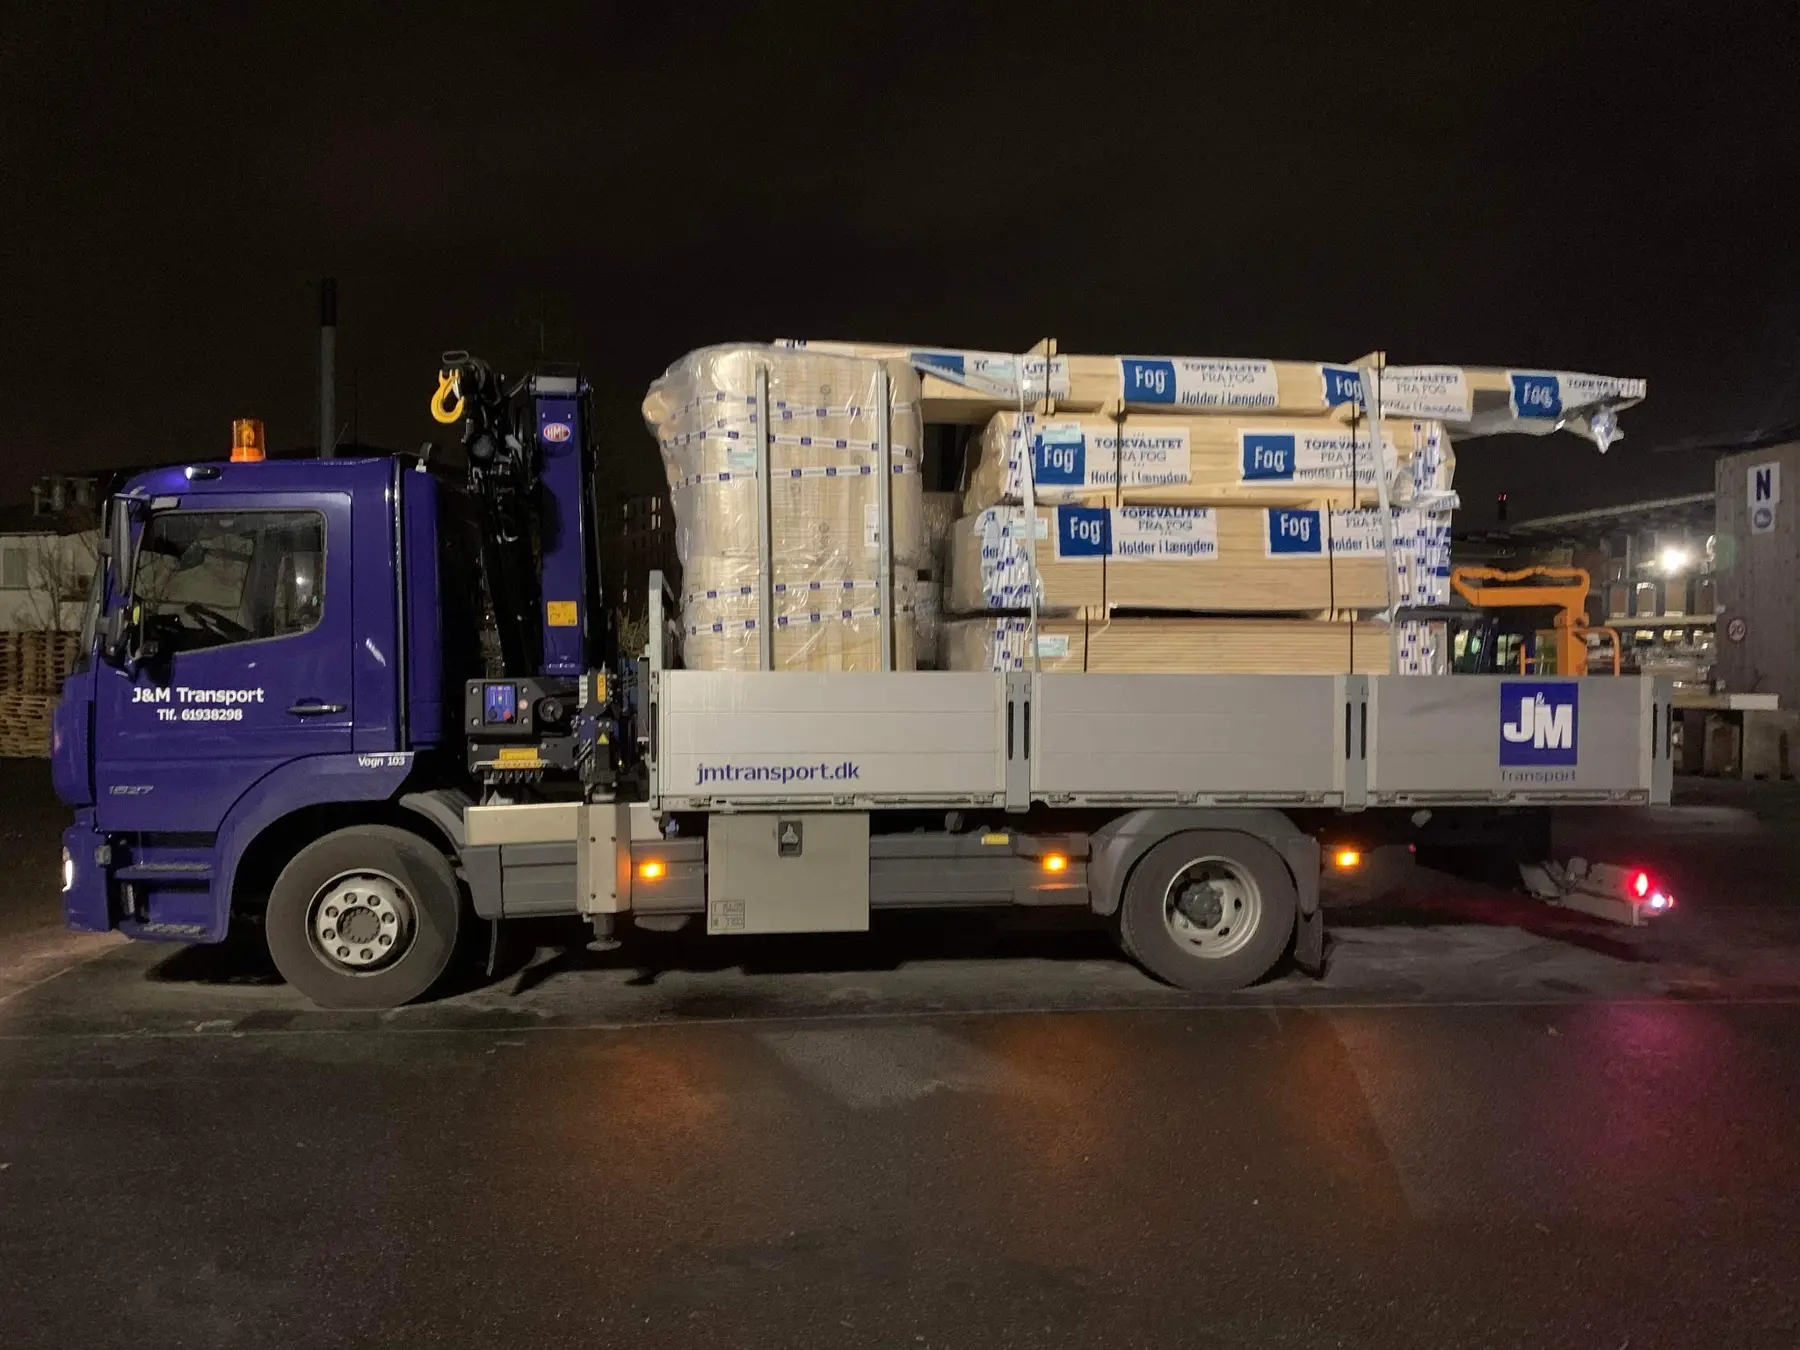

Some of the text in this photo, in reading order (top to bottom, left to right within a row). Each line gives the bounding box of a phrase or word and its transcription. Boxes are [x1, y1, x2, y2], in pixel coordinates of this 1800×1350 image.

[1135, 366, 1166, 394] Fog
[1335, 375, 1362, 401] Fog
[1182, 390, 1217, 405] Holder
[1228, 391, 1275, 408] længden
[1095, 438, 1184, 449] TOPKVALITET
[1043, 445, 1075, 473] Fog
[1140, 451, 1167, 462] FOG
[1254, 445, 1285, 472] Fog
[1091, 470, 1128, 484] Holder
[1137, 470, 1187, 486] længden
[1756, 469, 1771, 501] N
[1120, 508, 1208, 518] TOPKVALITET
[1070, 516, 1101, 545] Fog
[1138, 521, 1193, 532] FRA FOG
[1280, 514, 1311, 542] Fog
[1118, 539, 1155, 555] Holder
[1165, 539, 1214, 556] længden
[132, 687, 265, 706] J&M Transport
[157, 708, 243, 721] Tlf. 61938298
[358, 756, 405, 768] Vogn 103
[695, 761, 860, 786] jmtransport.dk
[1502, 769, 1577, 783] Transport
